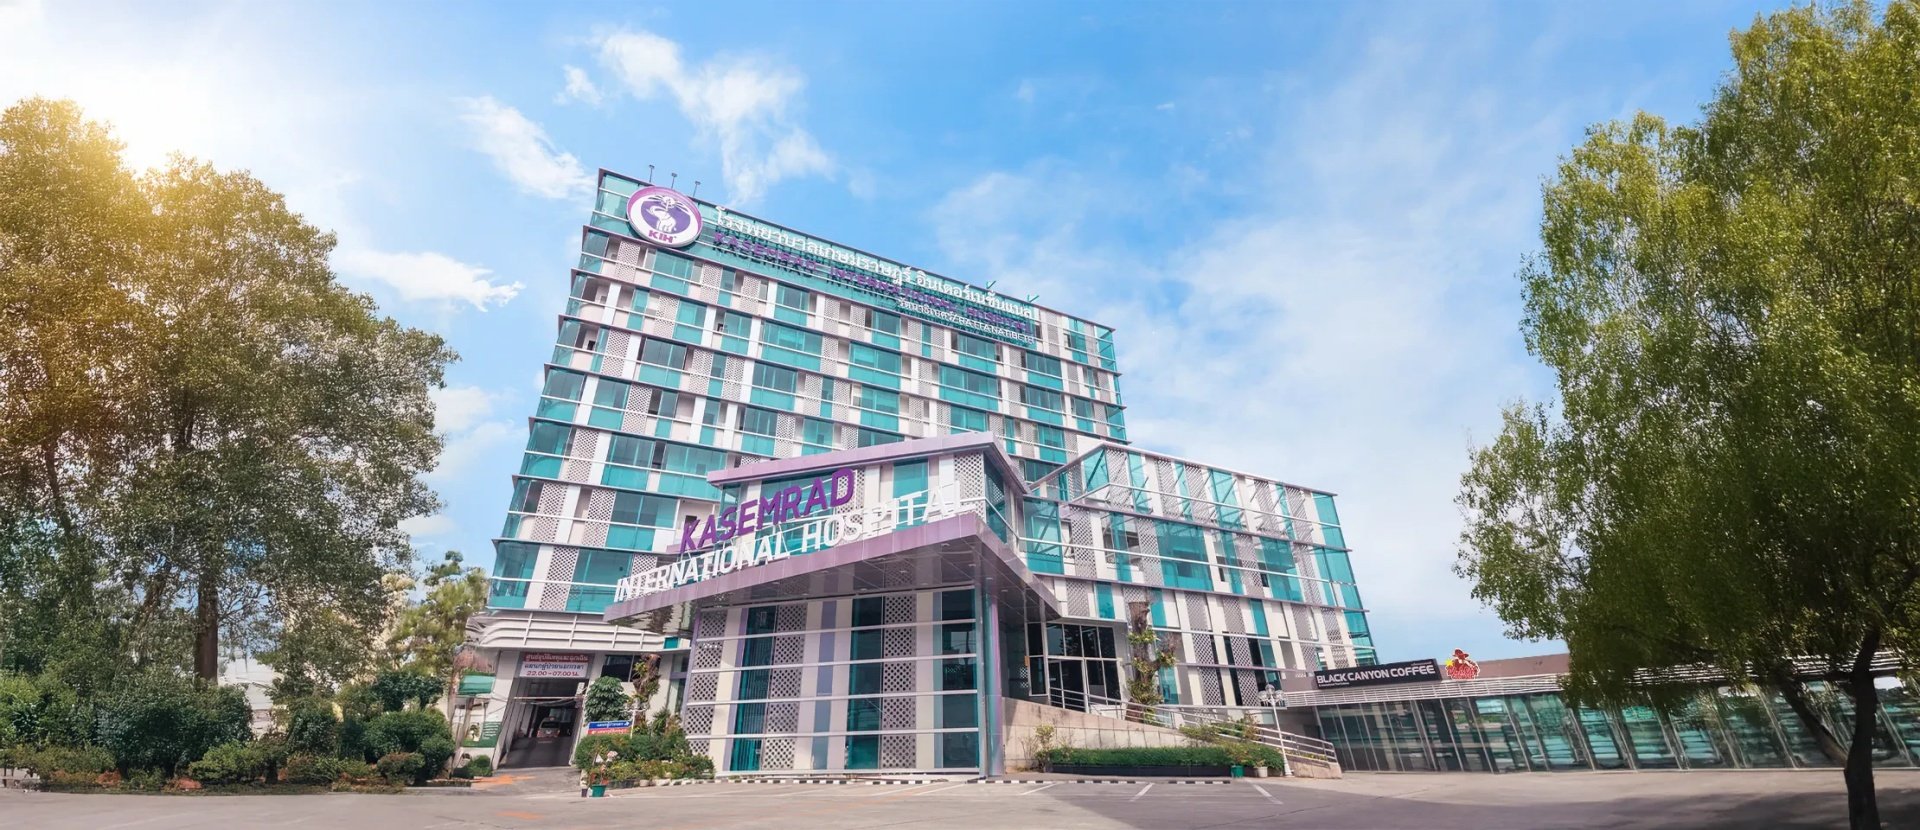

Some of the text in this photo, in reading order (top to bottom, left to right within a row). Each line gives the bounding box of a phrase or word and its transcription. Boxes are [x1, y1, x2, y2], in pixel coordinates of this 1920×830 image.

[648, 230, 674, 243] KIH
[713, 232, 818, 271] KASEMRAD
[716, 206, 912, 285] โรงพยาบาลเกษมราษฎร์
[679, 468, 855, 554] KASEMRAD
[614, 480, 974, 602] INTERNATIONAL HOSPITAL
[1316, 673, 1347, 685] BLACK
[1347, 669, 1390, 682] CANYON
[1390, 664, 1436, 678] COFFEE
